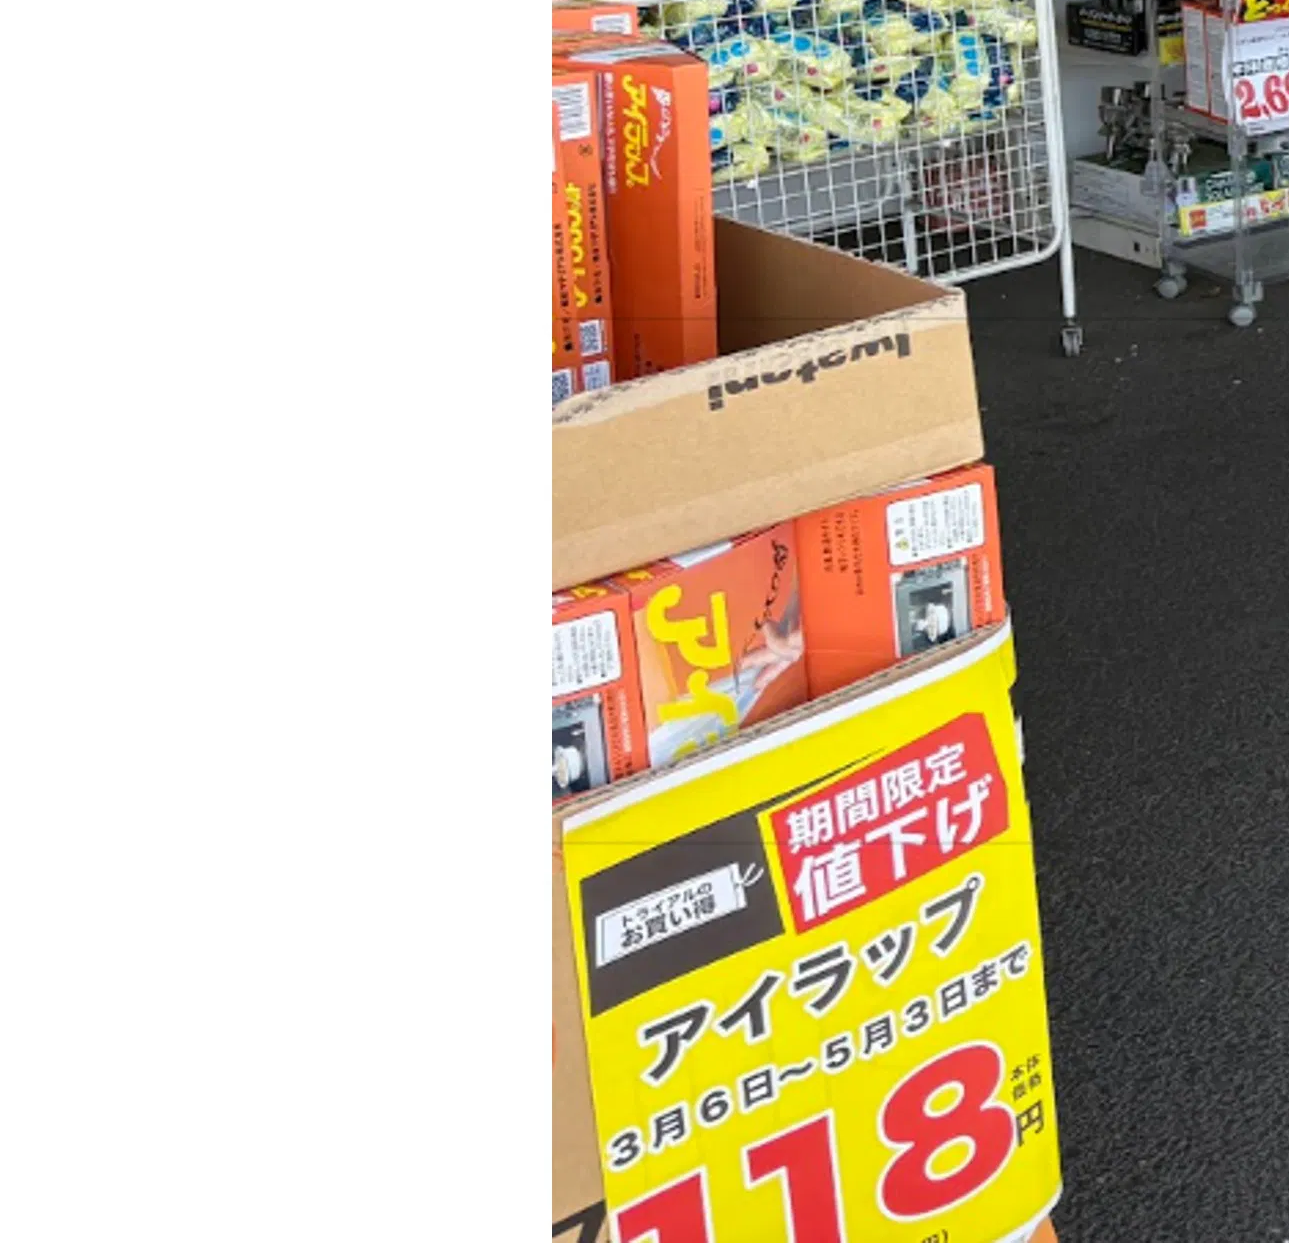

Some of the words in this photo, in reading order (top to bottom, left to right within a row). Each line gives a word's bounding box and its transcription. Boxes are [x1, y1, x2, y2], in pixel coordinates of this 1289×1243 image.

[785, 742, 967, 854] 期間限定
[794, 774, 993, 922] 値下げ
[620, 894, 717, 948] お買い得
[621, 881, 713, 929] トライアルの
[640, 876, 984, 1082] アイラップ
[1016, 1099, 1045, 1147] 円
